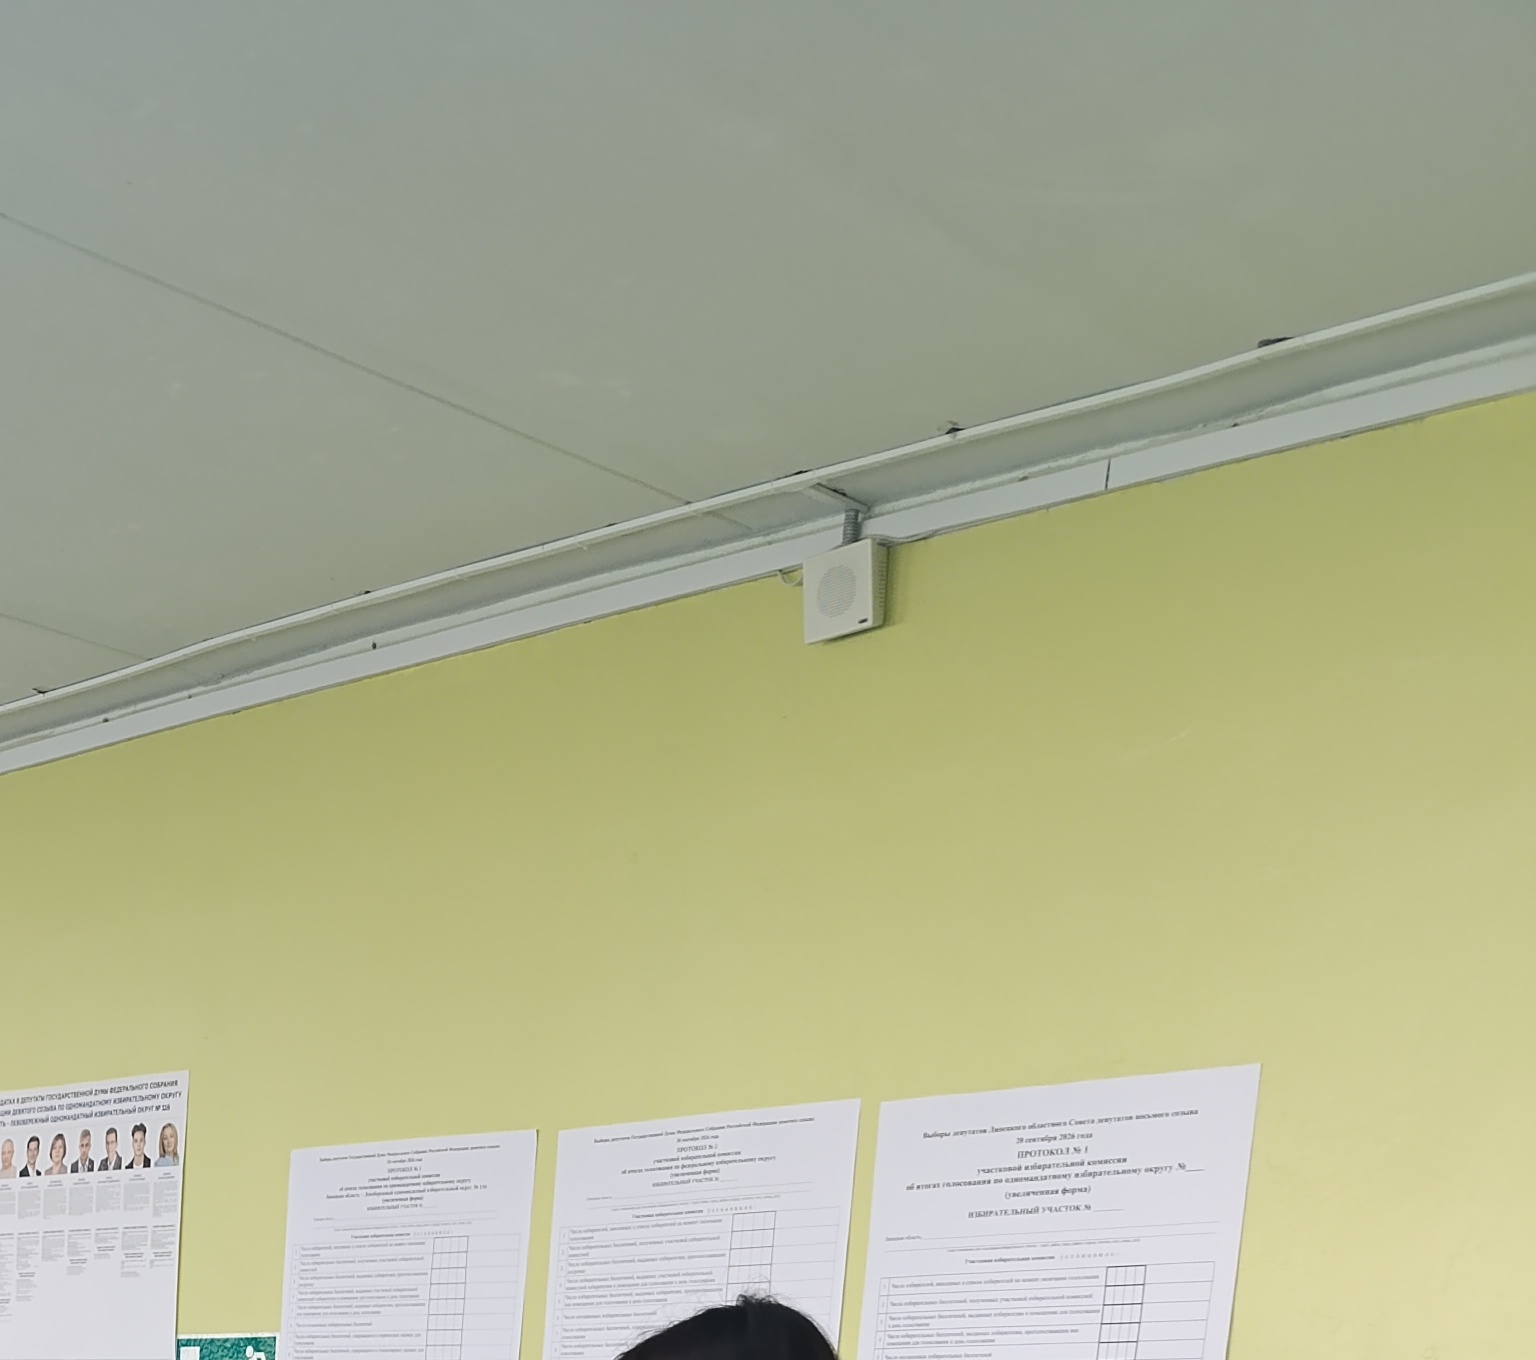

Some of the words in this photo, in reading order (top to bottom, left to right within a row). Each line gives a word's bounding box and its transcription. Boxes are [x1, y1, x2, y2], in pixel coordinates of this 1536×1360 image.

[20, 1095, 44, 1104] ДЕПУТАТЫ
[45, 1088, 94, 1101] ГОСУДАРСТВЕННОЙ
[94, 1088, 109, 1096] ДУМЫ
[109, 1083, 149, 1094] ФЕДЕРАЛЬНОГО
[149, 1079, 178, 1089] СОБРАНИЯ
[65, 1098, 112, 1110] ОДНОМАНДАТНОМУ
[112, 1094, 160, 1104] ИЗБИРАТЕЛЬНОМУ
[160, 1091, 183, 1100] ОКРУГУ
[50, 1110, 94, 1122] ОДНОМАНДАТНЫЙ
[94, 1106, 137, 1117] ИЗБИРАТЕЛЬНЫЙ
[137, 1105, 154, 1113] ОКРУГ
[923, 1131, 951, 1139] Выборы
[952, 1128, 987, 1137] депутатов
[988, 1124, 1026, 1133] Липецкого
[1028, 1119, 1067, 1130] областного
[1068, 1118, 1095, 1126] Совета
[1096, 1115, 1133, 1124] депутатов
[1135, 1111, 1170, 1120] восьмого
[1171, 1109, 1199, 1117] созыва
[1025, 1135, 1057, 1144] сентября
[1017, 1147, 1070, 1159] ПРОТОКОЛ
[1071, 1146, 1081, 1154] №
[977, 1164, 1022, 1175] участковой
[1024, 1159, 1085, 1171] избирательной
[1087, 1157, 1127, 1166] комиссии
[906, 1183, 914, 1191] об
[916, 1182, 940, 1190] итогах
[942, 1179, 991, 1188] голосования
[1004, 1173, 1072, 1184] одномандатному
[1074, 1166, 1142, 1179] избирательному
[1144, 1164, 1173, 1174] округу
[1175, 1162, 1186, 1170] №
[1004, 1187, 1059, 1199] (увеличенная
[1061, 1185, 1091, 1195] форма)
[968, 1206, 1040, 1218] ИЗБИРАТЕЛЬНЫЙ
[1041, 1204, 1082, 1214] УЧАСТОК
